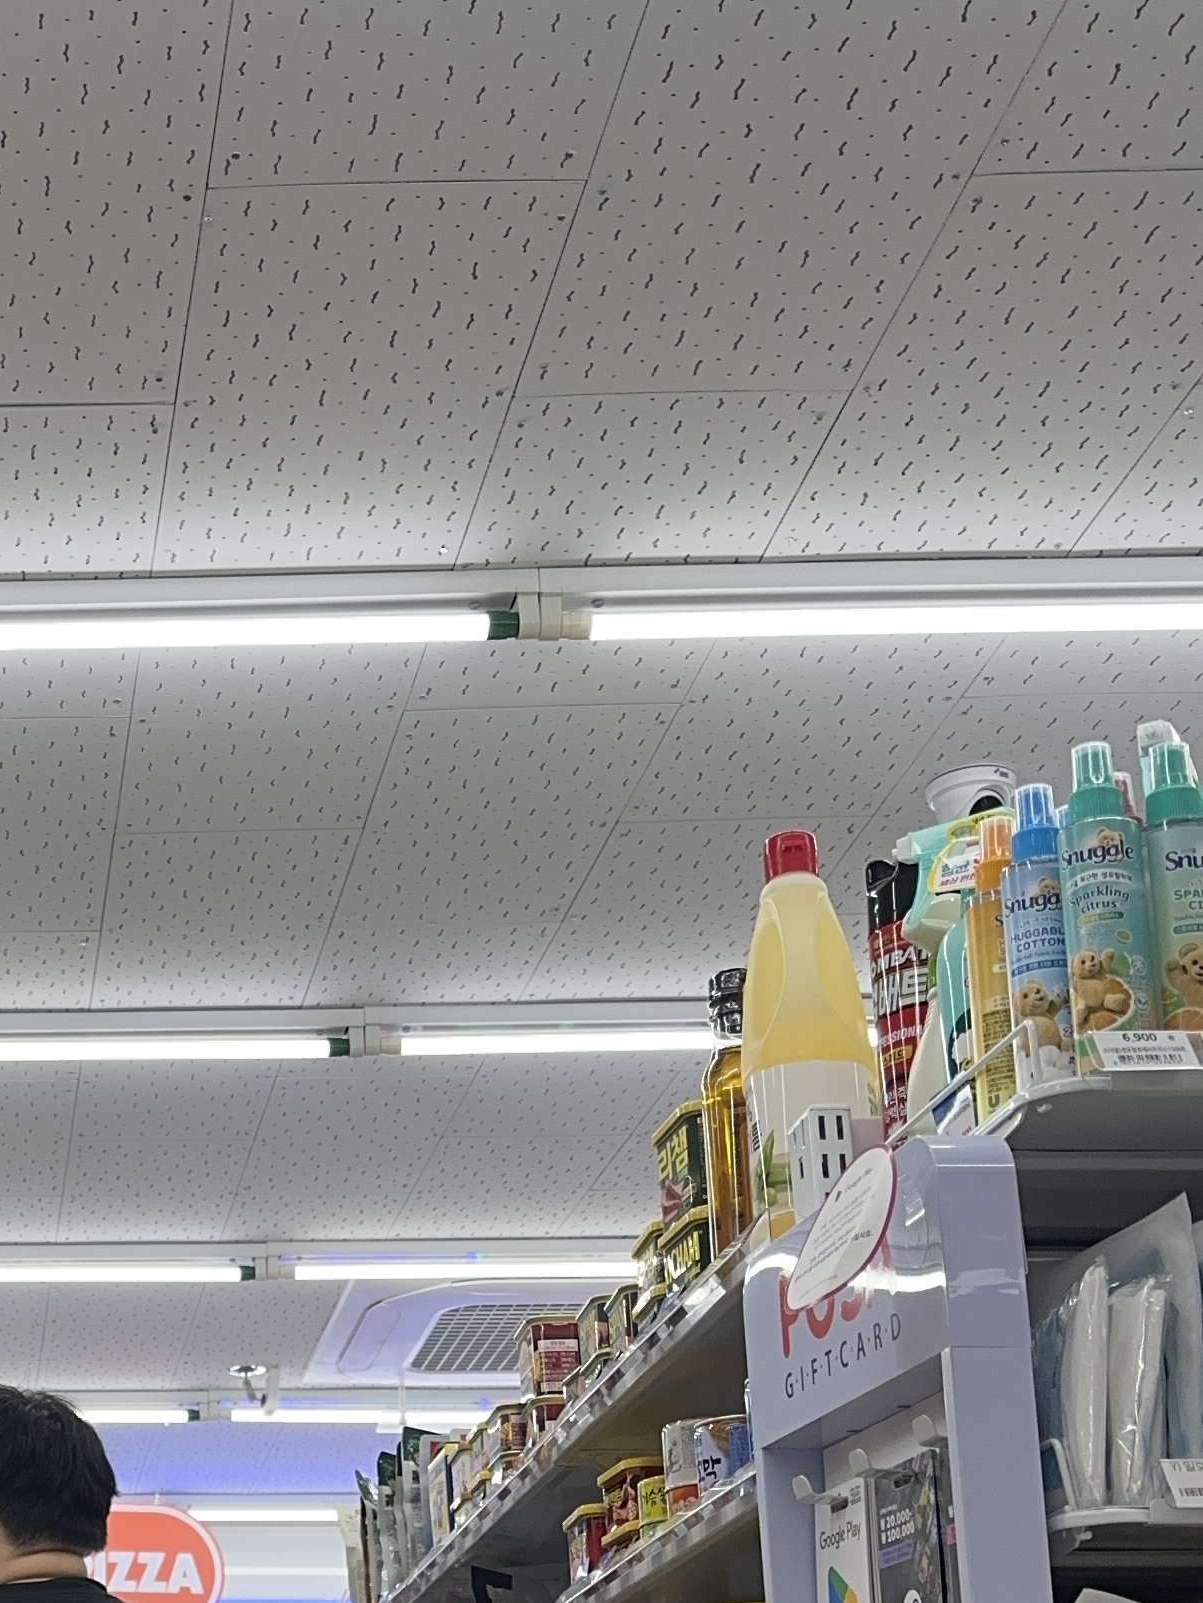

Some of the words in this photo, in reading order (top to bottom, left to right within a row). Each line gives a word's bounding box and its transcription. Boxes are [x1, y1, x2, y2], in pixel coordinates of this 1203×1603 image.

[1061, 833, 1135, 871] Snuggle
[1069, 886, 1130, 909] Sparkling
[1081, 900, 1117, 914] citrus
[1122, 1033, 1158, 1042] 6,900
[658, 1125, 689, 1181] 리챔
[820, 1524, 845, 1550] Google
[847, 1520, 862, 1541] Play
[87, 1552, 204, 1594] IZZA
